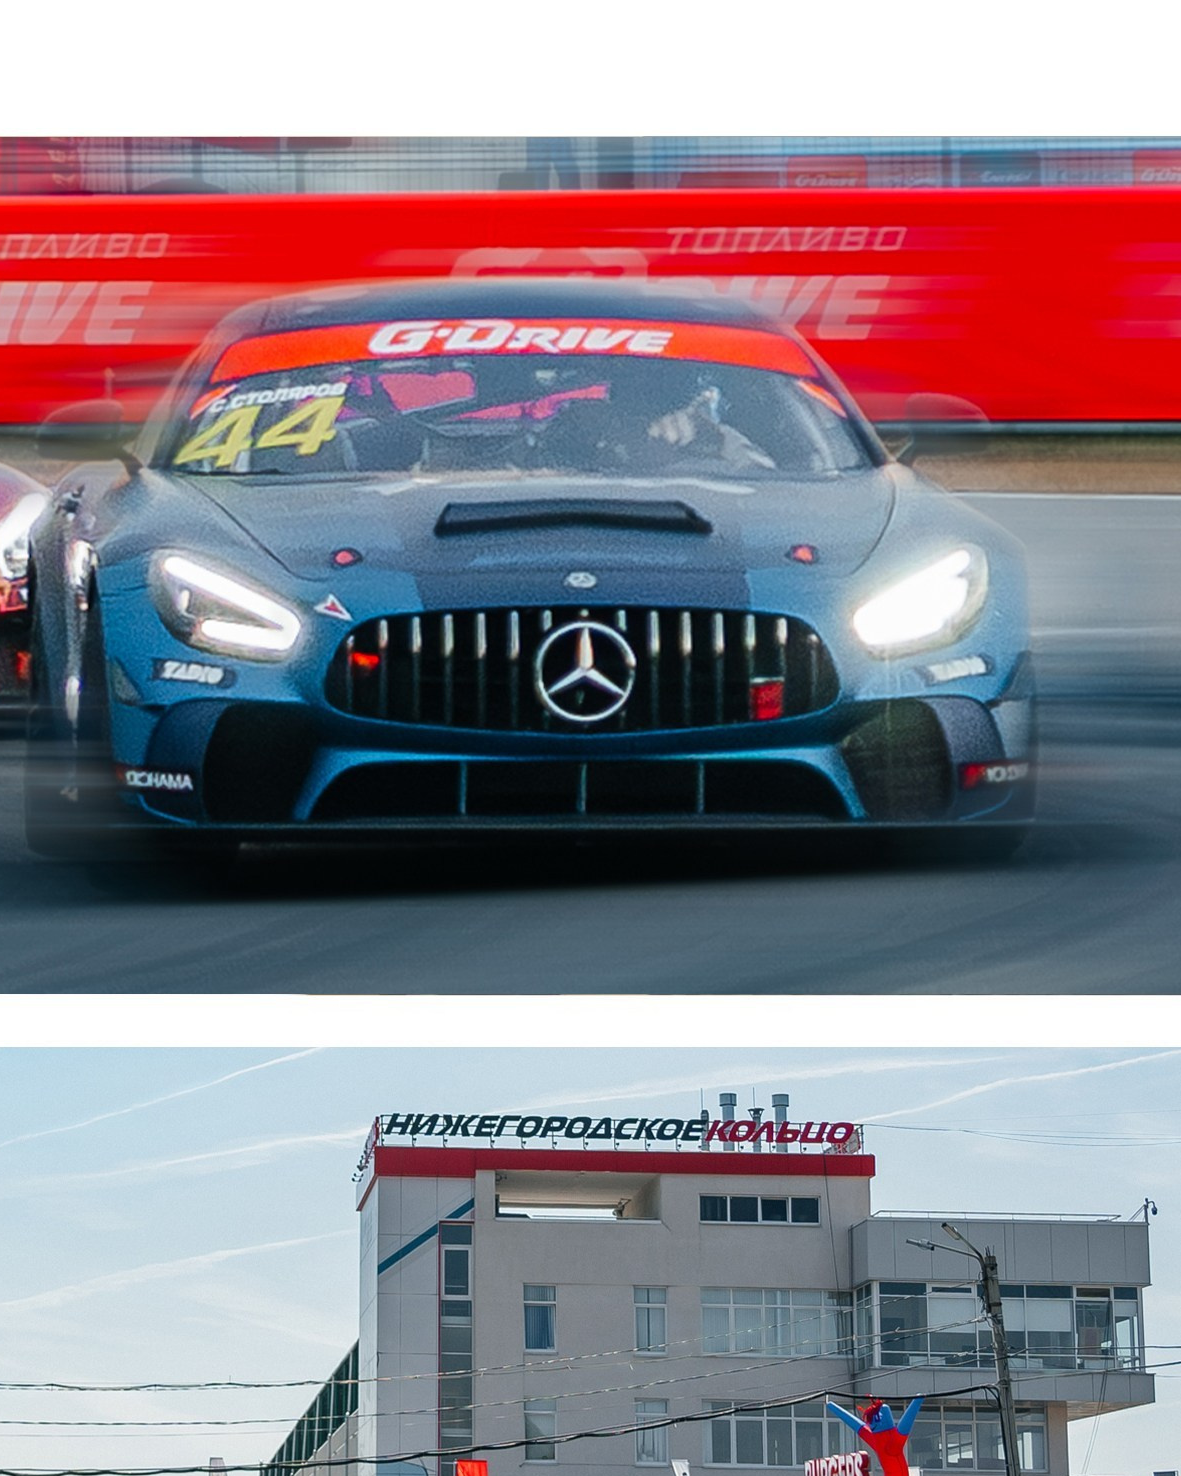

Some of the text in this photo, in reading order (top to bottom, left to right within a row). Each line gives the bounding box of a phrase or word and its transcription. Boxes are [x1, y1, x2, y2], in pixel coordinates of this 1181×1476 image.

[667, 226, 908, 254] ТОПЛИВО
[173, 396, 346, 467] 44
[384, 1113, 854, 1144] НИЖЕГОРОДСКОЕ КОЛЬЦО
